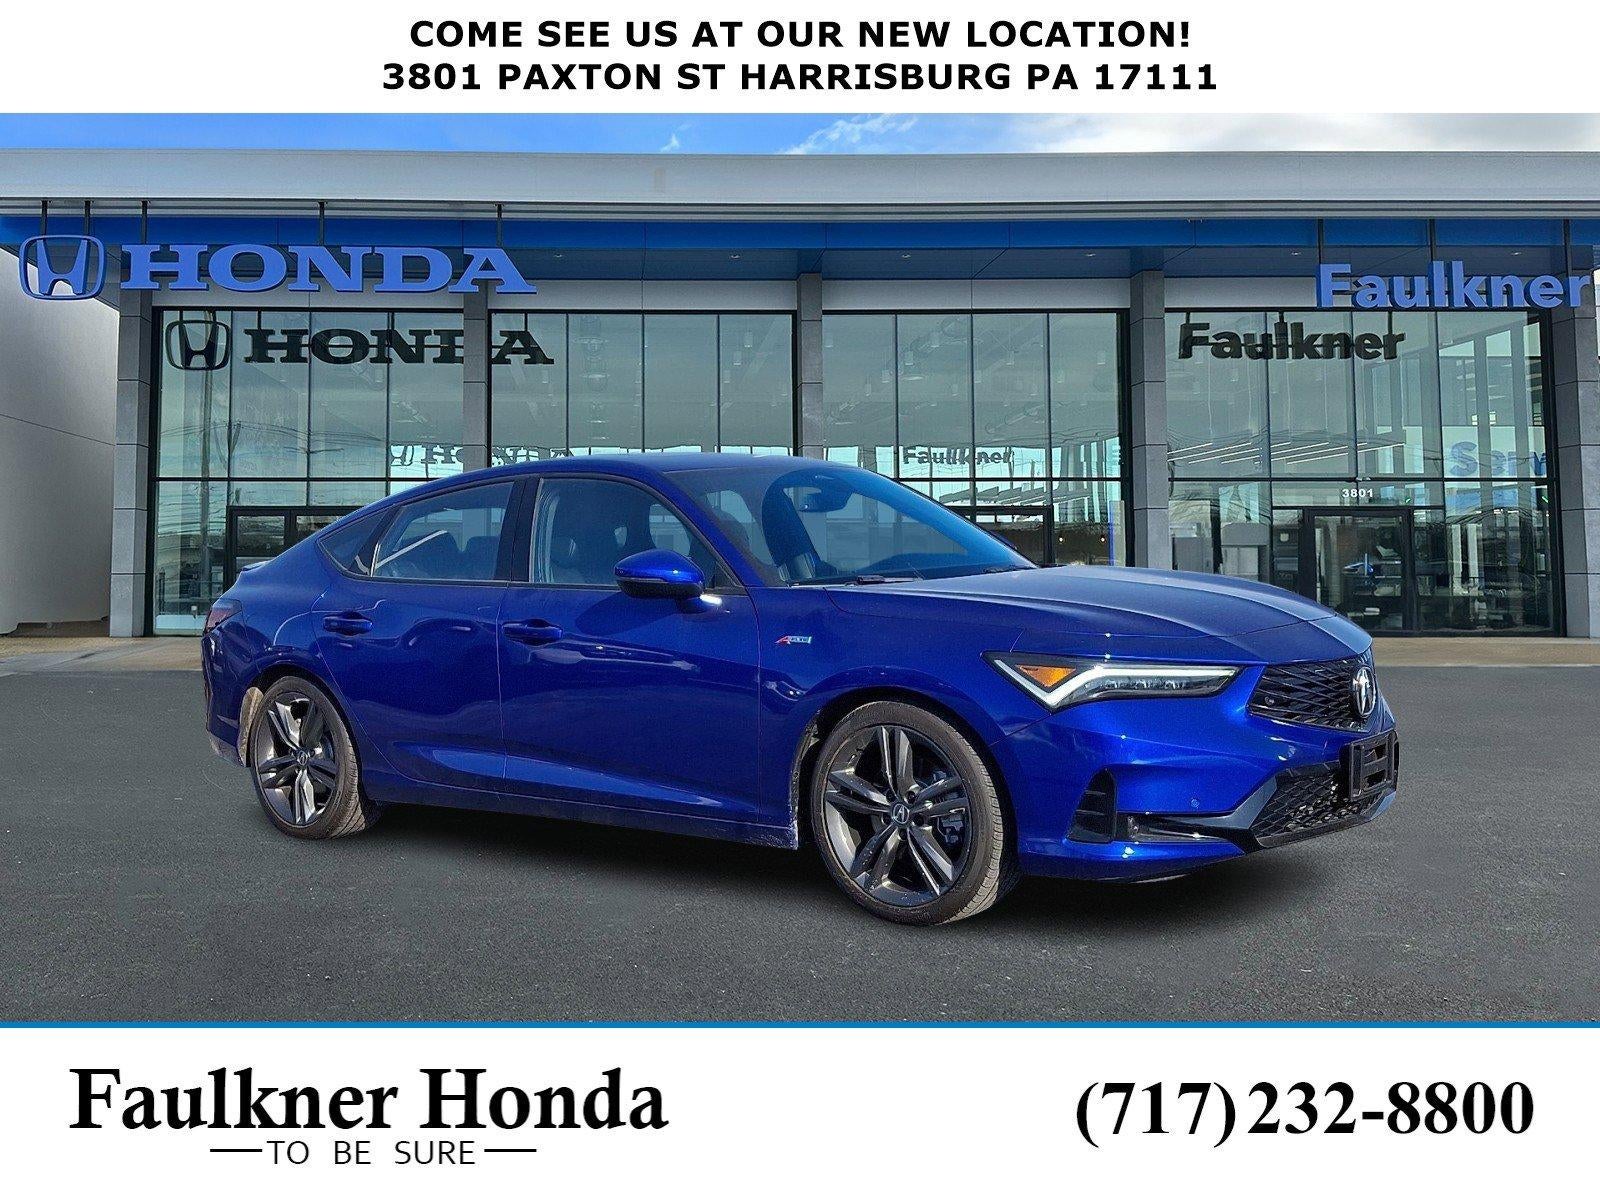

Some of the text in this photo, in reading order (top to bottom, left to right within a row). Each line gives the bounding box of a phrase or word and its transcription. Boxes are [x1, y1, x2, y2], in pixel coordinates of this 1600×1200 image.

[121, 244, 537, 294] HONDA
[1316, 260, 1591, 309] Faulkner
[1178, 320, 1405, 361] Faulkner
[903, 446, 1015, 465] Faulkner
[1342, 488, 1374, 498] 3801
